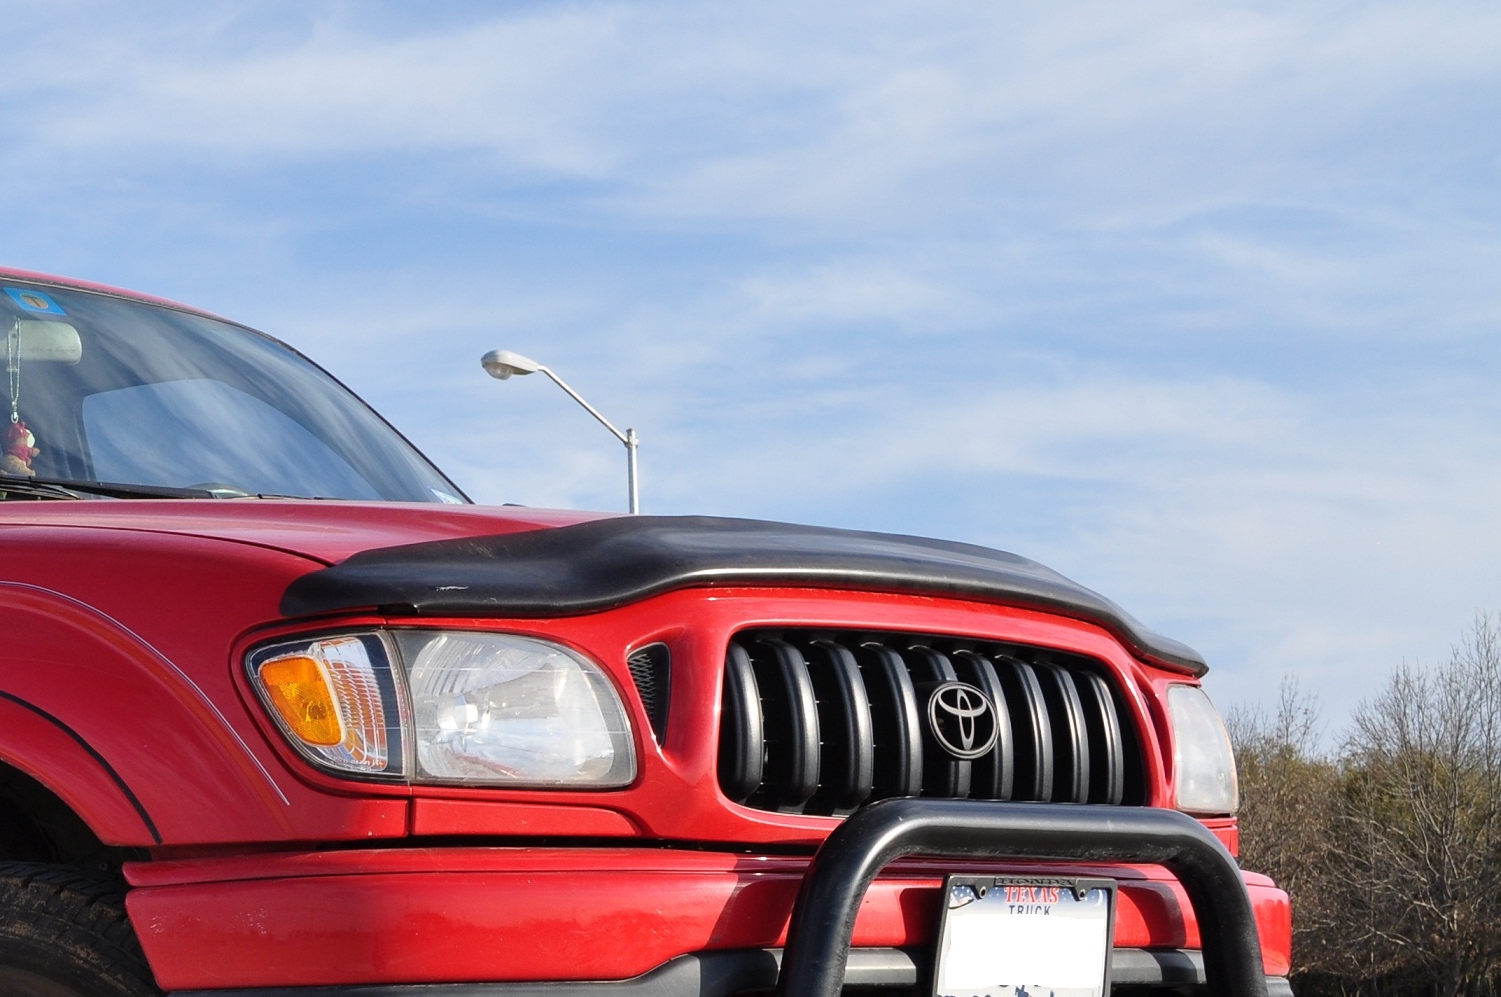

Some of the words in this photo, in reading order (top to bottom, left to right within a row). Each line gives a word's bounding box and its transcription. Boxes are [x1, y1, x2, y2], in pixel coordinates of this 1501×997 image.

[997, 877, 1075, 886] HONDA
[1004, 886, 1060, 903] TEXAS
[1009, 905, 1051, 916] TRUCK
